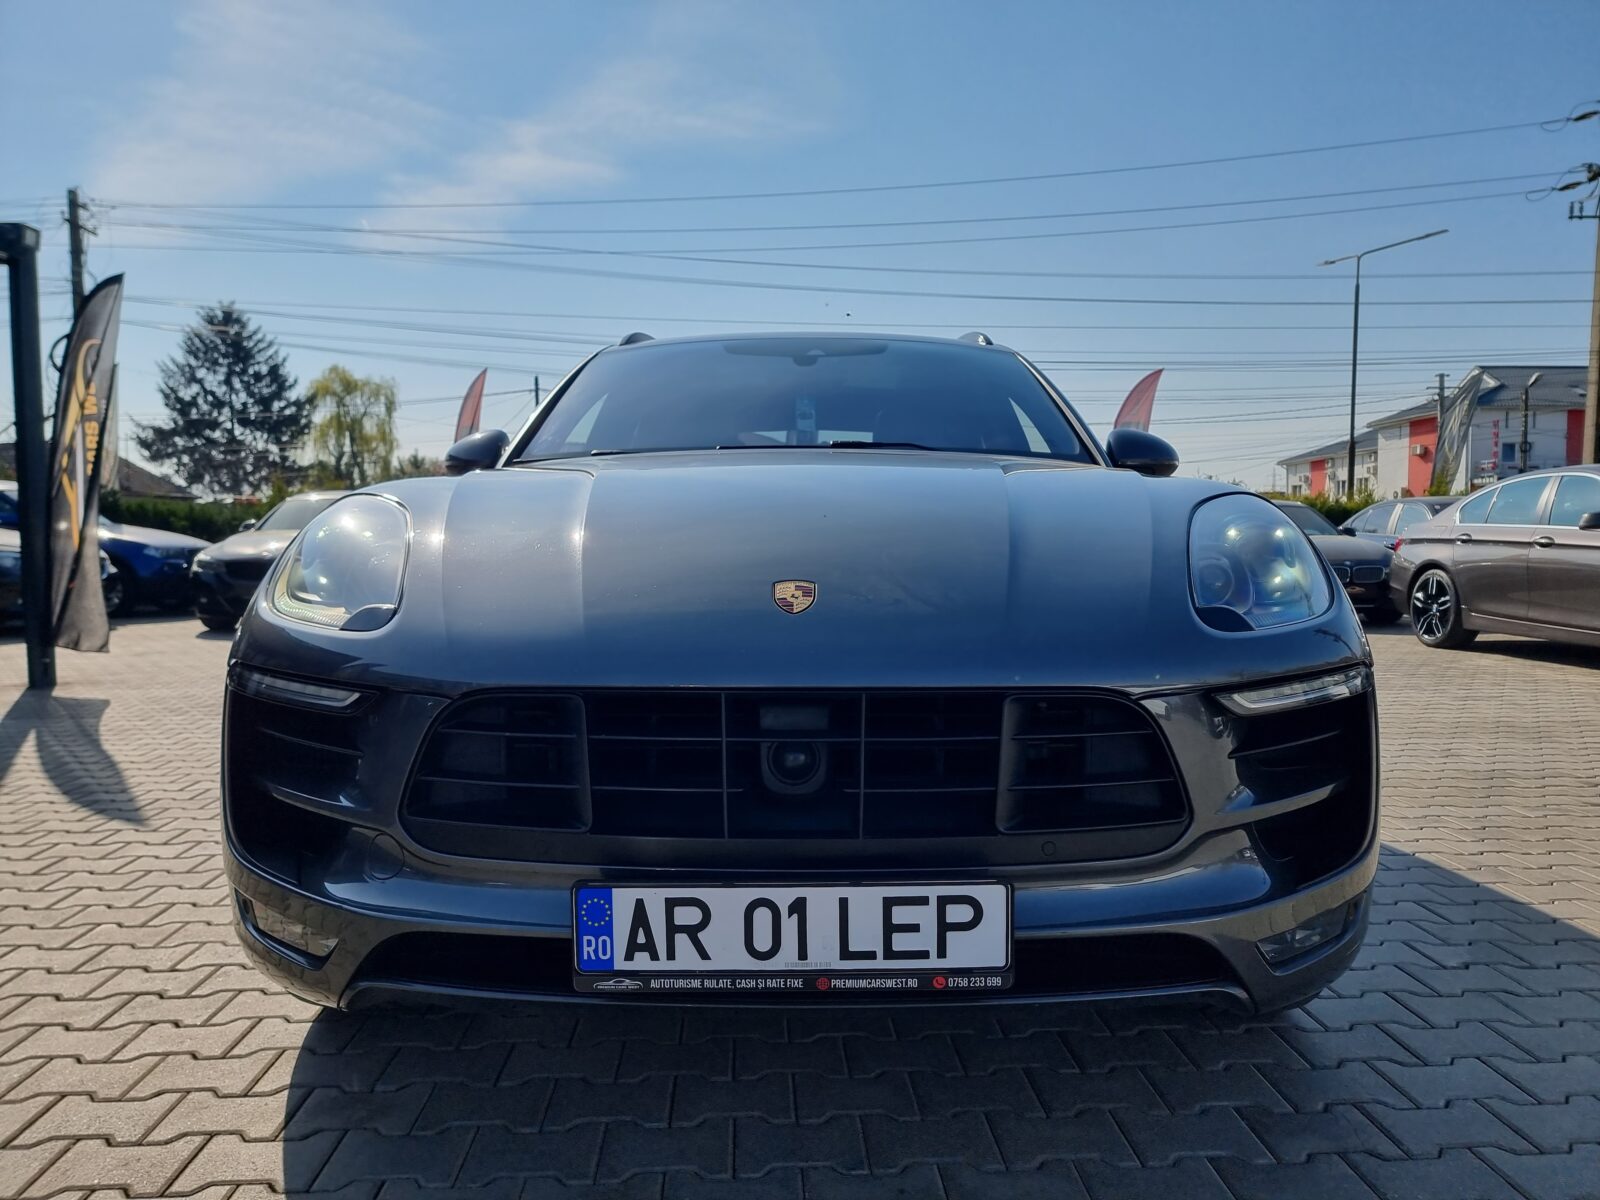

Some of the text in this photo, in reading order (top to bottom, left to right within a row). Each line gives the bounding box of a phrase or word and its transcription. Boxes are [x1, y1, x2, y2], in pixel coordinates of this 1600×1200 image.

[623, 894, 984, 962] AR 01 LEP
[582, 935, 611, 960] RO
[650, 978, 702, 989] AUTOTURISME
[703, 979, 734, 990] RULATE,
[736, 978, 756, 989] CASH
[766, 978, 785, 989] RATE
[786, 978, 804, 988] FIXE
[831, 978, 918, 989] PREMIUMCARSWEST.RO
[948, 976, 1002, 988] 0758 233 699
